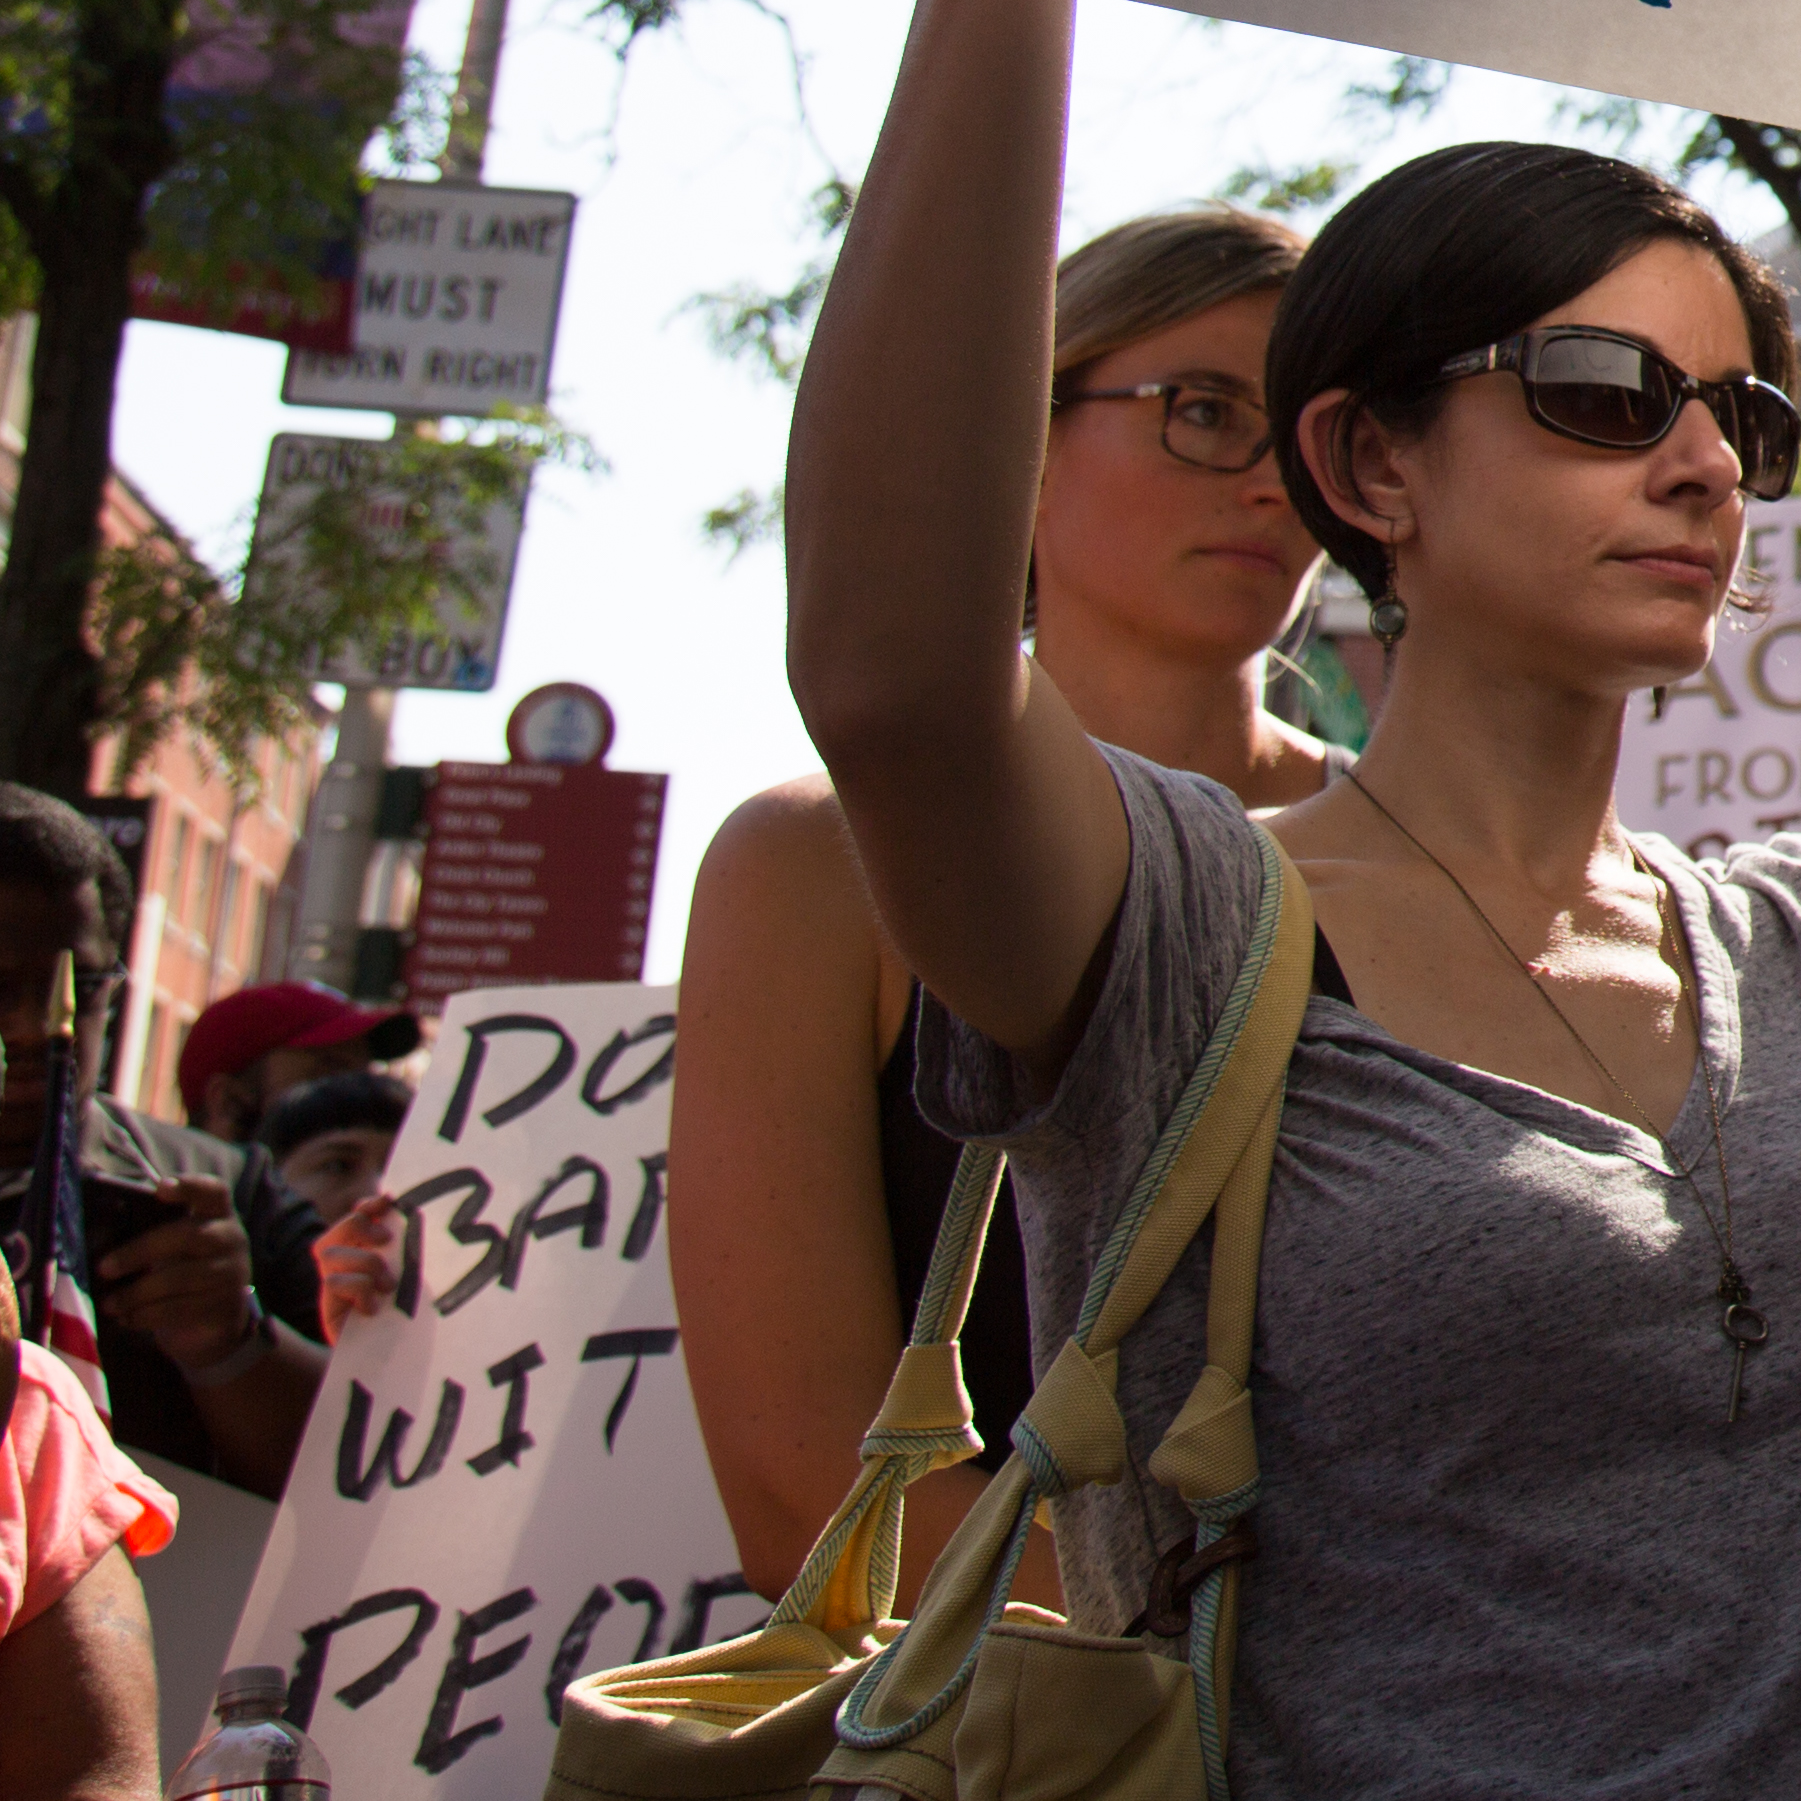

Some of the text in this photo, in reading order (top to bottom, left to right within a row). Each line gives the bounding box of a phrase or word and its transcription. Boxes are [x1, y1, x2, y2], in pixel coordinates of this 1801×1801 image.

[456, 210, 558, 256] LANE
[363, 271, 507, 326] MUST
[423, 347, 538, 393] RIGHT
